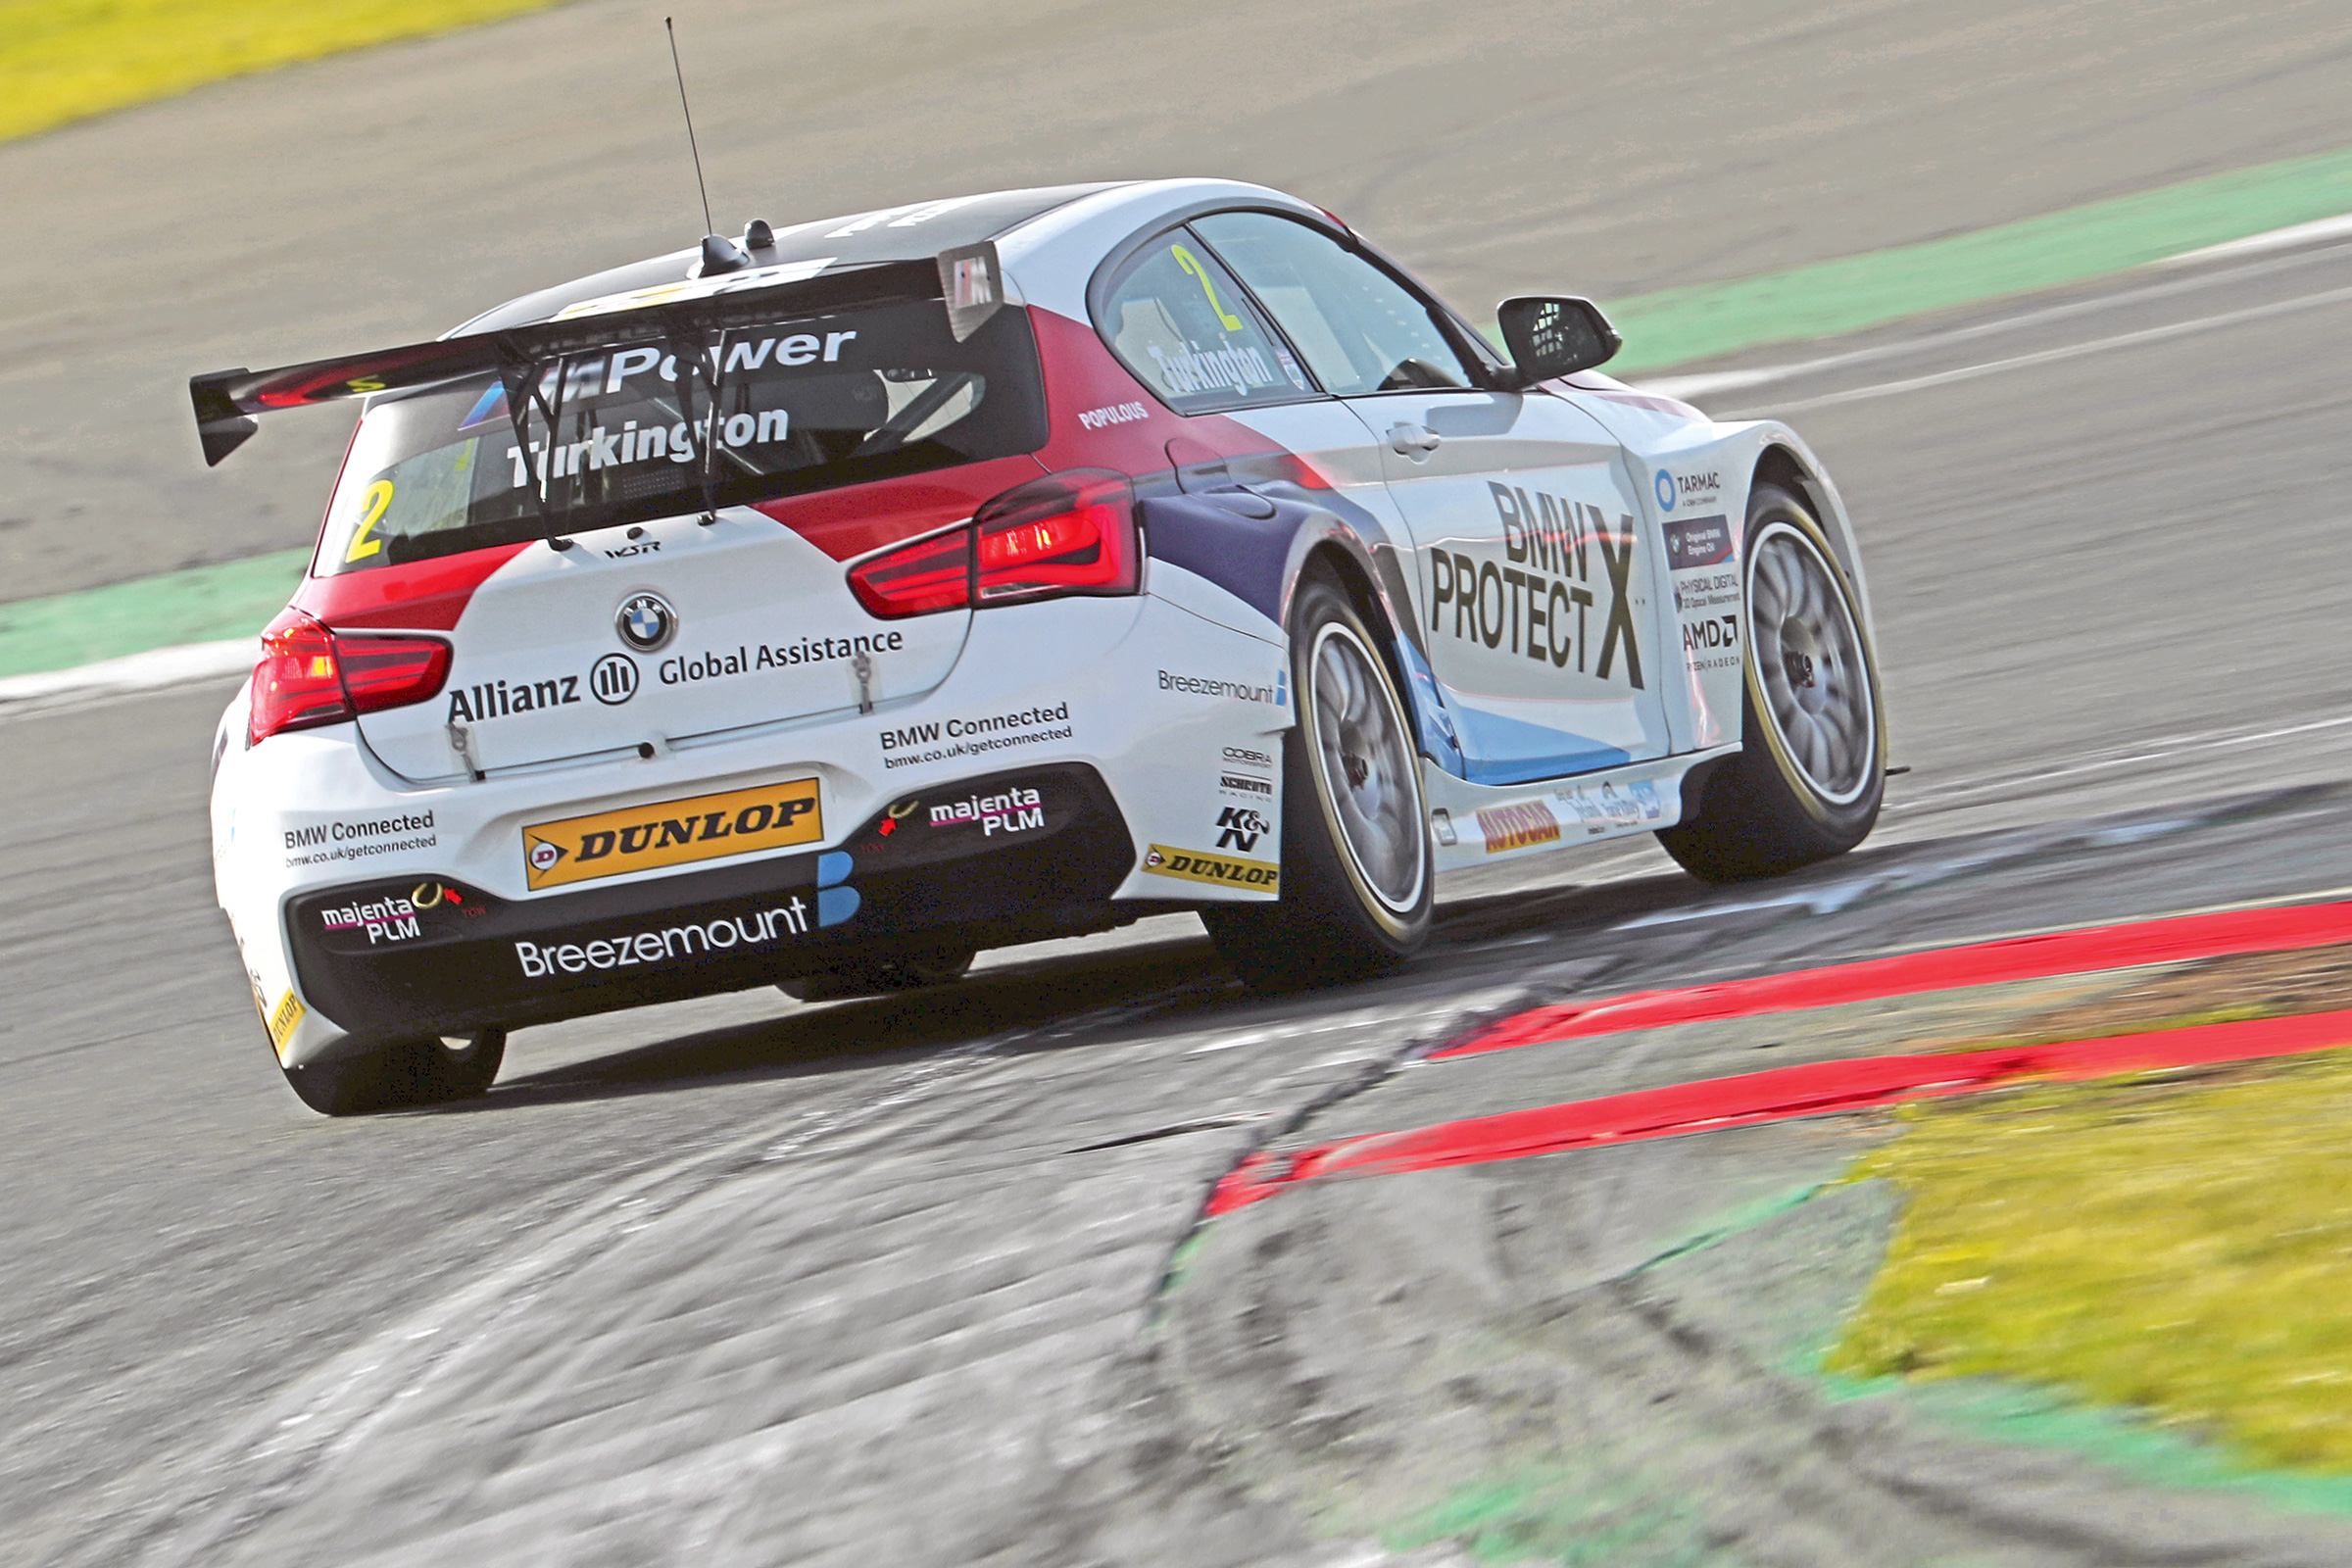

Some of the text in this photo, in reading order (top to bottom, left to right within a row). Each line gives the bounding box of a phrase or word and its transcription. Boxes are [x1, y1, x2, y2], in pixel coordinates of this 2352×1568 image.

[1171, 244, 1243, 331] 2
[1078, 402, 1149, 430] POPULOUS
[1677, 472, 1721, 494] TARMAC
[345, 479, 394, 564] 2
[1487, 480, 1587, 582] BMW
[604, 541, 661, 559] WSR
[1688, 544, 1706, 557] Engine
[1586, 504, 1644, 690] X
[1680, 573, 1740, 594] PHYSICAL DIGITAL
[1431, 547, 1593, 673] PROTECT
[1683, 619, 1720, 651] AMD
[659, 630, 903, 686] Global Assistance
[448, 674, 581, 723] Allianz
[1158, 669, 1273, 704] Breezemount
[880, 702, 1069, 751] BMW Connected
[884, 725, 1073, 769] bmw.co.uk/getconnected
[1222, 747, 1272, 763] COBRA
[930, 787, 1041, 821] majenta
[284, 809, 435, 849] BMW Connected
[574, 797, 815, 862] DUNLOP
[983, 808, 1045, 837] PLM
[285, 834, 437, 868] bmw.co.uk/getconnected
[1166, 855, 1278, 885] DUNLOP
[321, 896, 415, 926] majenta
[366, 916, 422, 945] PLM
[514, 896, 808, 978] Breezemount
